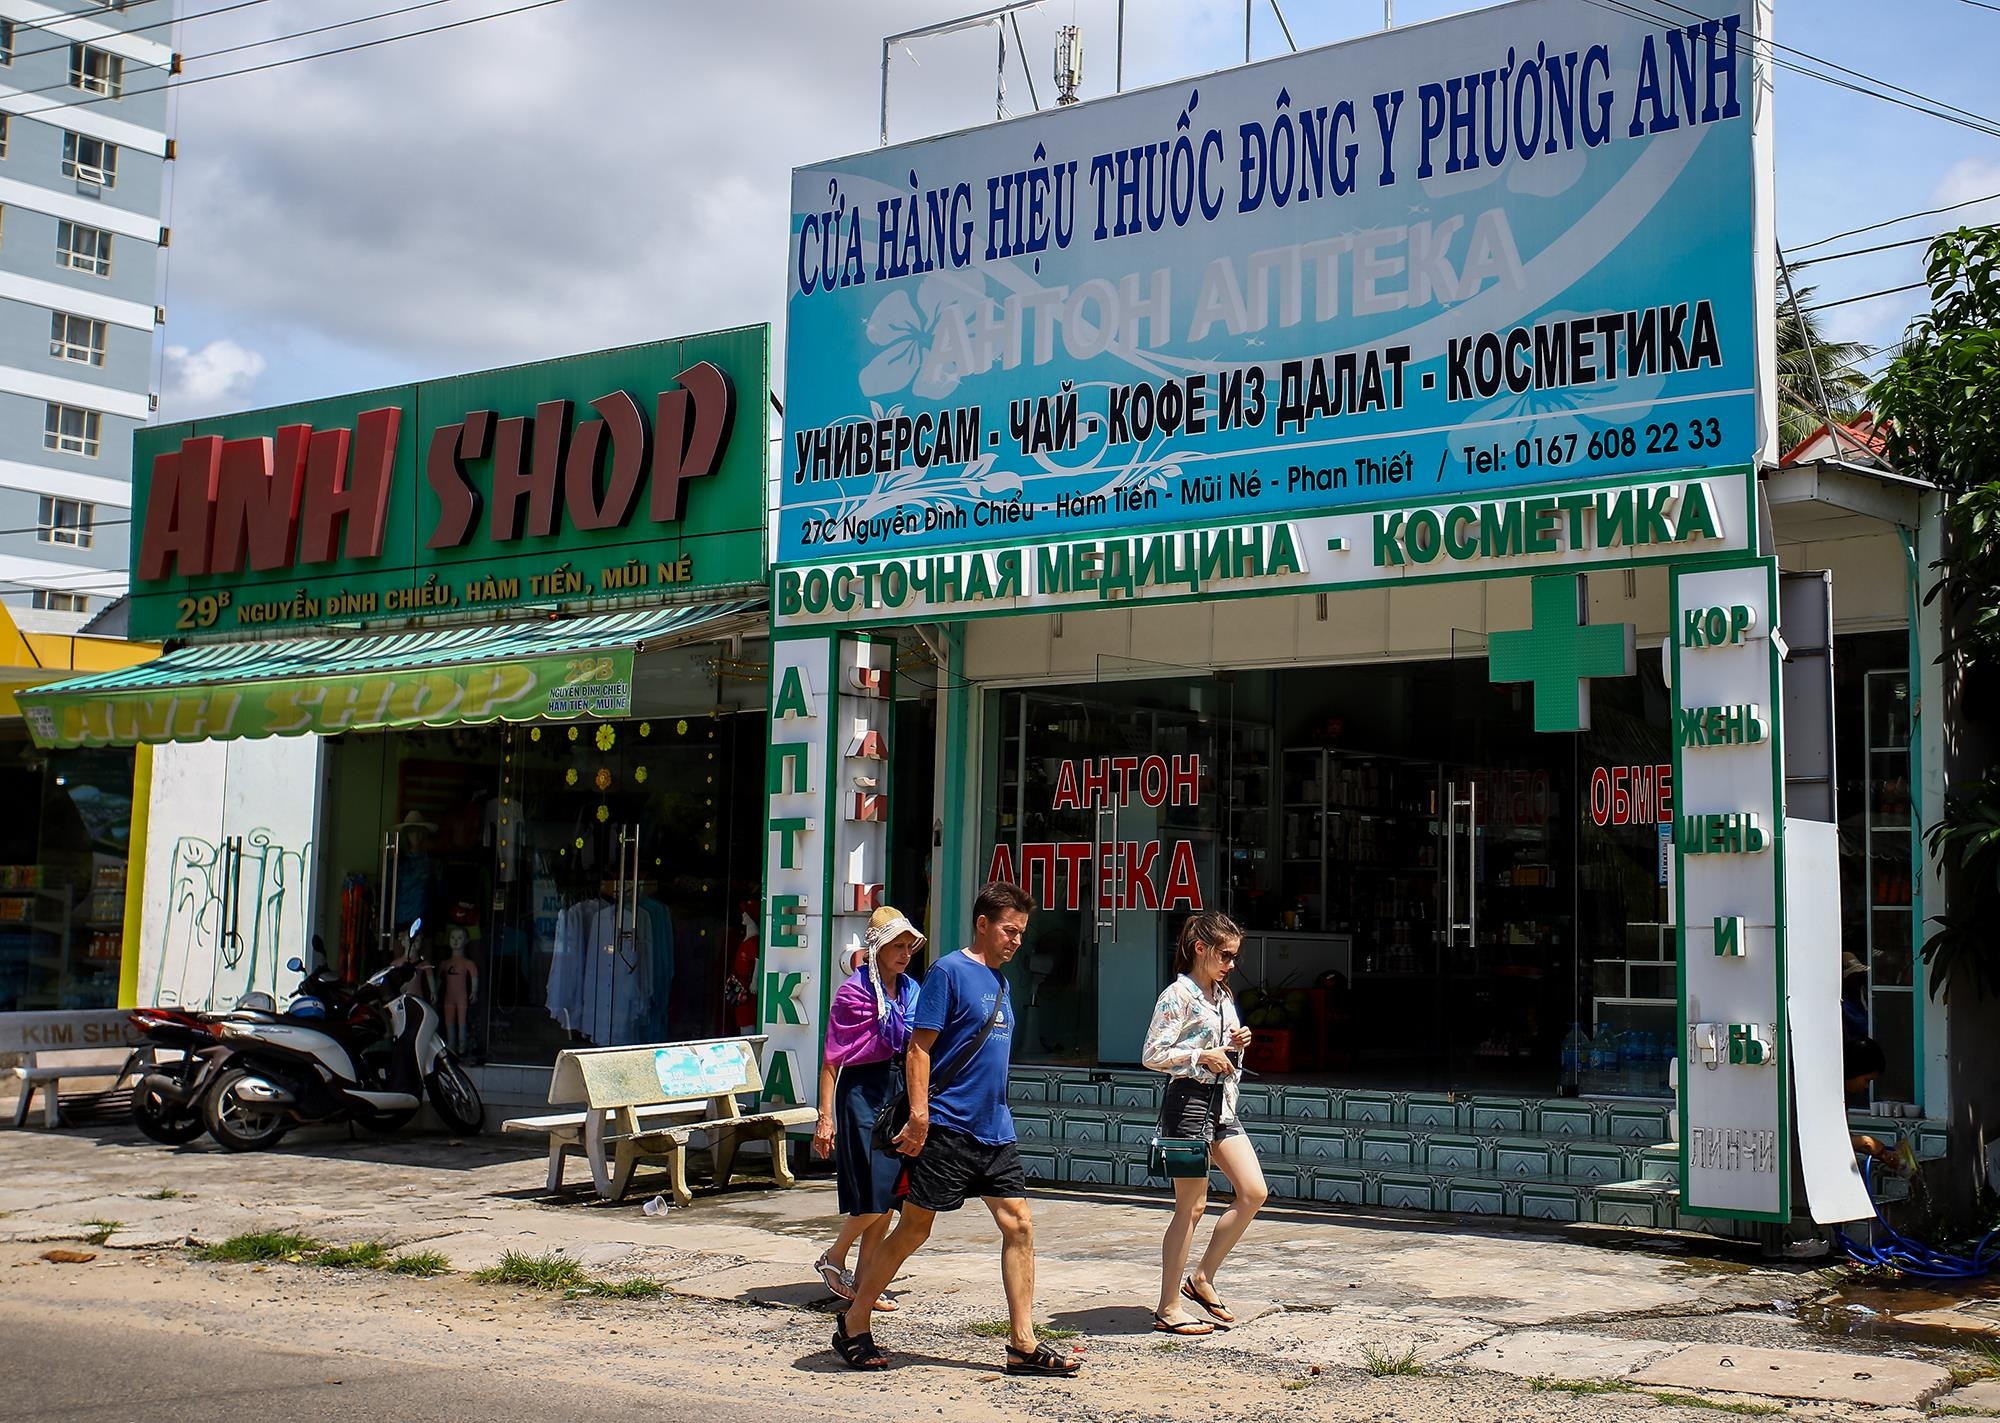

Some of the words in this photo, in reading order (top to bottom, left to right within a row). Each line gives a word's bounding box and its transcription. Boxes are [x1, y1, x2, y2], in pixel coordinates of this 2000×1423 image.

[799, 177, 865, 296] CỬA
[875, 169, 974, 282] HÀNG
[985, 141, 1077, 275] HIỆU
[1089, 88, 1224, 241] THUỐC
[1237, 86, 1358, 214] ĐÔNG
[1373, 90, 1403, 186] Y
[1417, 40, 1614, 180] PHƯƠNG
[1628, 14, 1741, 138] ANH
[925, 266, 1172, 381] АНТОН
[1191, 207, 1524, 341] АПТЕКА
[794, 405, 981, 485] УНИВЕРСАМ
[1009, 379, 1077, 456] ЧАЙ
[1109, 375, 1206, 445] КОФЕ
[1218, 365, 1265, 430] ИЗ
[1275, 344, 1410, 436] ДАЛАТ
[1447, 299, 1723, 402] КОСМЕТИКА
[137, 406, 402, 582] ANH
[426, 360, 737, 550] SHOP
[801, 518, 837, 544] 27C
[843, 505, 917, 545] Nguyễn
[924, 502, 967, 531] Đình
[973, 490, 1034, 526] Chiểu
[1056, 490, 1106, 518] Hàm
[1113, 479, 1157, 513] Tiến
[1181, 475, 1222, 505] Mũi
[1230, 469, 1261, 499] Né
[1288, 464, 1347, 493] Phan
[1355, 451, 1413, 484] Thiết
[1463, 444, 1506, 474] Tel:
[1516, 434, 1578, 468] 0167
[1587, 427, 1636, 460] 608
[1645, 422, 1679, 454] 22
[1688, 417, 1722, 450] 33
[779, 547, 1030, 616] ВОСТОЧНАЯ
[1036, 521, 1309, 600] МЕДИЦИНА
[1373, 481, 1725, 567] КОСМЕТИКА
[237, 588, 320, 624] NGUYỄN
[326, 589, 377, 615] ĐÌNH
[384, 572, 459, 609] CHIỂU,
[466, 574, 519, 601] HÀM
[529, 562, 593, 596] TIẾN,
[601, 559, 647, 589] MŨI
[657, 552, 692, 584] NÉ
[1684, 604, 1757, 648] КОР
[63, 692, 240, 741] ANH
[263, 664, 536, 731] SHOP
[565, 657, 613, 682] 29B
[1052, 753, 1201, 811] АНТОН
[1590, 764, 1673, 826] ОБМЕ
[761, 665, 817, 1104] АПТЕКА
[986, 839, 1203, 911] АПТЕКА
[21, 1023, 73, 1044] KIM
[83, 1021, 146, 1044] SHO
